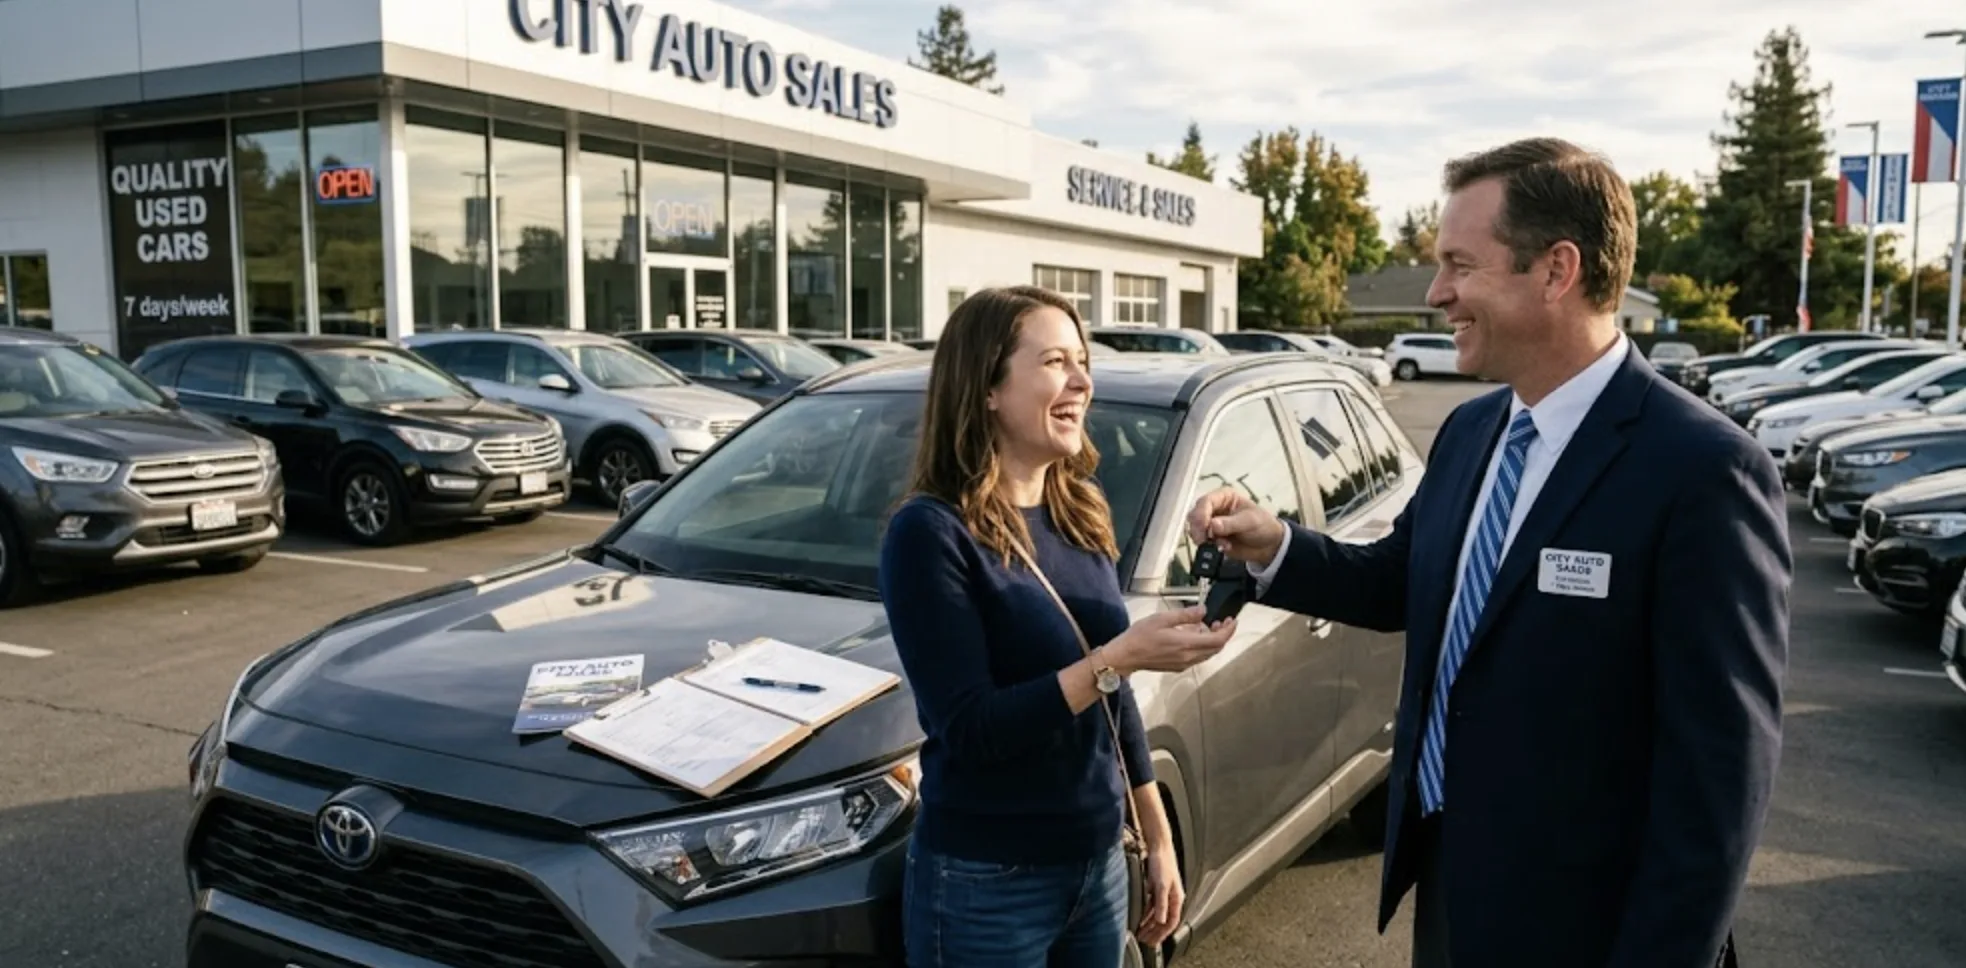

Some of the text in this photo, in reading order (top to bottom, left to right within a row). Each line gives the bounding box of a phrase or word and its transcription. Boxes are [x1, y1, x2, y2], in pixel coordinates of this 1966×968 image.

[508, 0, 897, 127] CITY AUTO SALES
[112, 157, 227, 194] QUALITY
[318, 168, 374, 198] OPEN
[135, 196, 207, 227] USED
[655, 200, 713, 234] OPEN
[137, 232, 209, 262] CARS
[124, 294, 230, 321] 7 days/week
